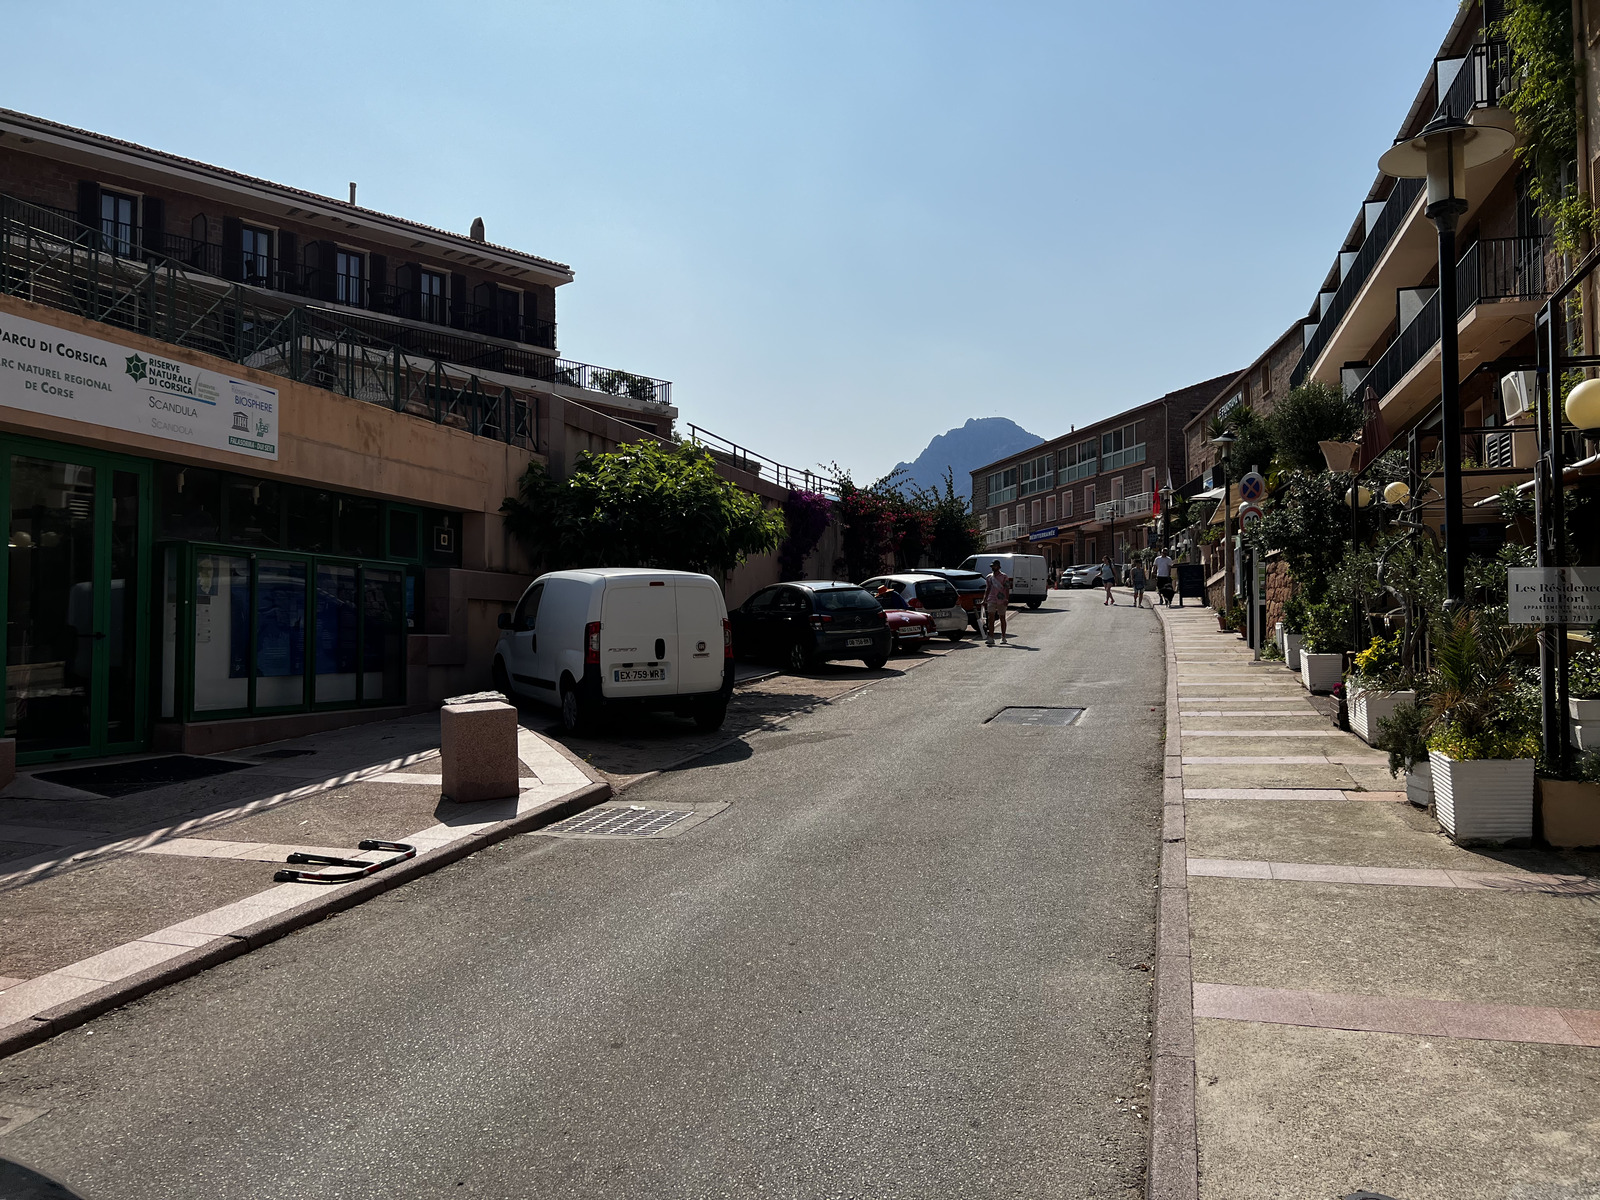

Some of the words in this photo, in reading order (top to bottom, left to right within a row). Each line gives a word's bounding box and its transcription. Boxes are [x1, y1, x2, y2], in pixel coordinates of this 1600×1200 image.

[0, 328, 36, 349] ARCU
[39, 341, 52, 353] DI
[149, 358, 180, 373] RISERVE
[17, 361, 62, 380] NATUREL
[64, 373, 113, 392] REGIONAL
[149, 368, 192, 386] NATURALE
[25, 380, 38, 391] DE
[40, 382, 74, 399] CORSE
[149, 377, 158, 386] DI
[159, 380, 194, 395] CORSICA
[149, 396, 198, 418] SCANDULA
[234, 395, 273, 413] BIOSPHERE
[151, 417, 194, 436] SCANDOLA
[1515, 583, 1537, 593] Les
[1539, 593, 1555, 603] du
[1559, 593, 1585, 603] Port
